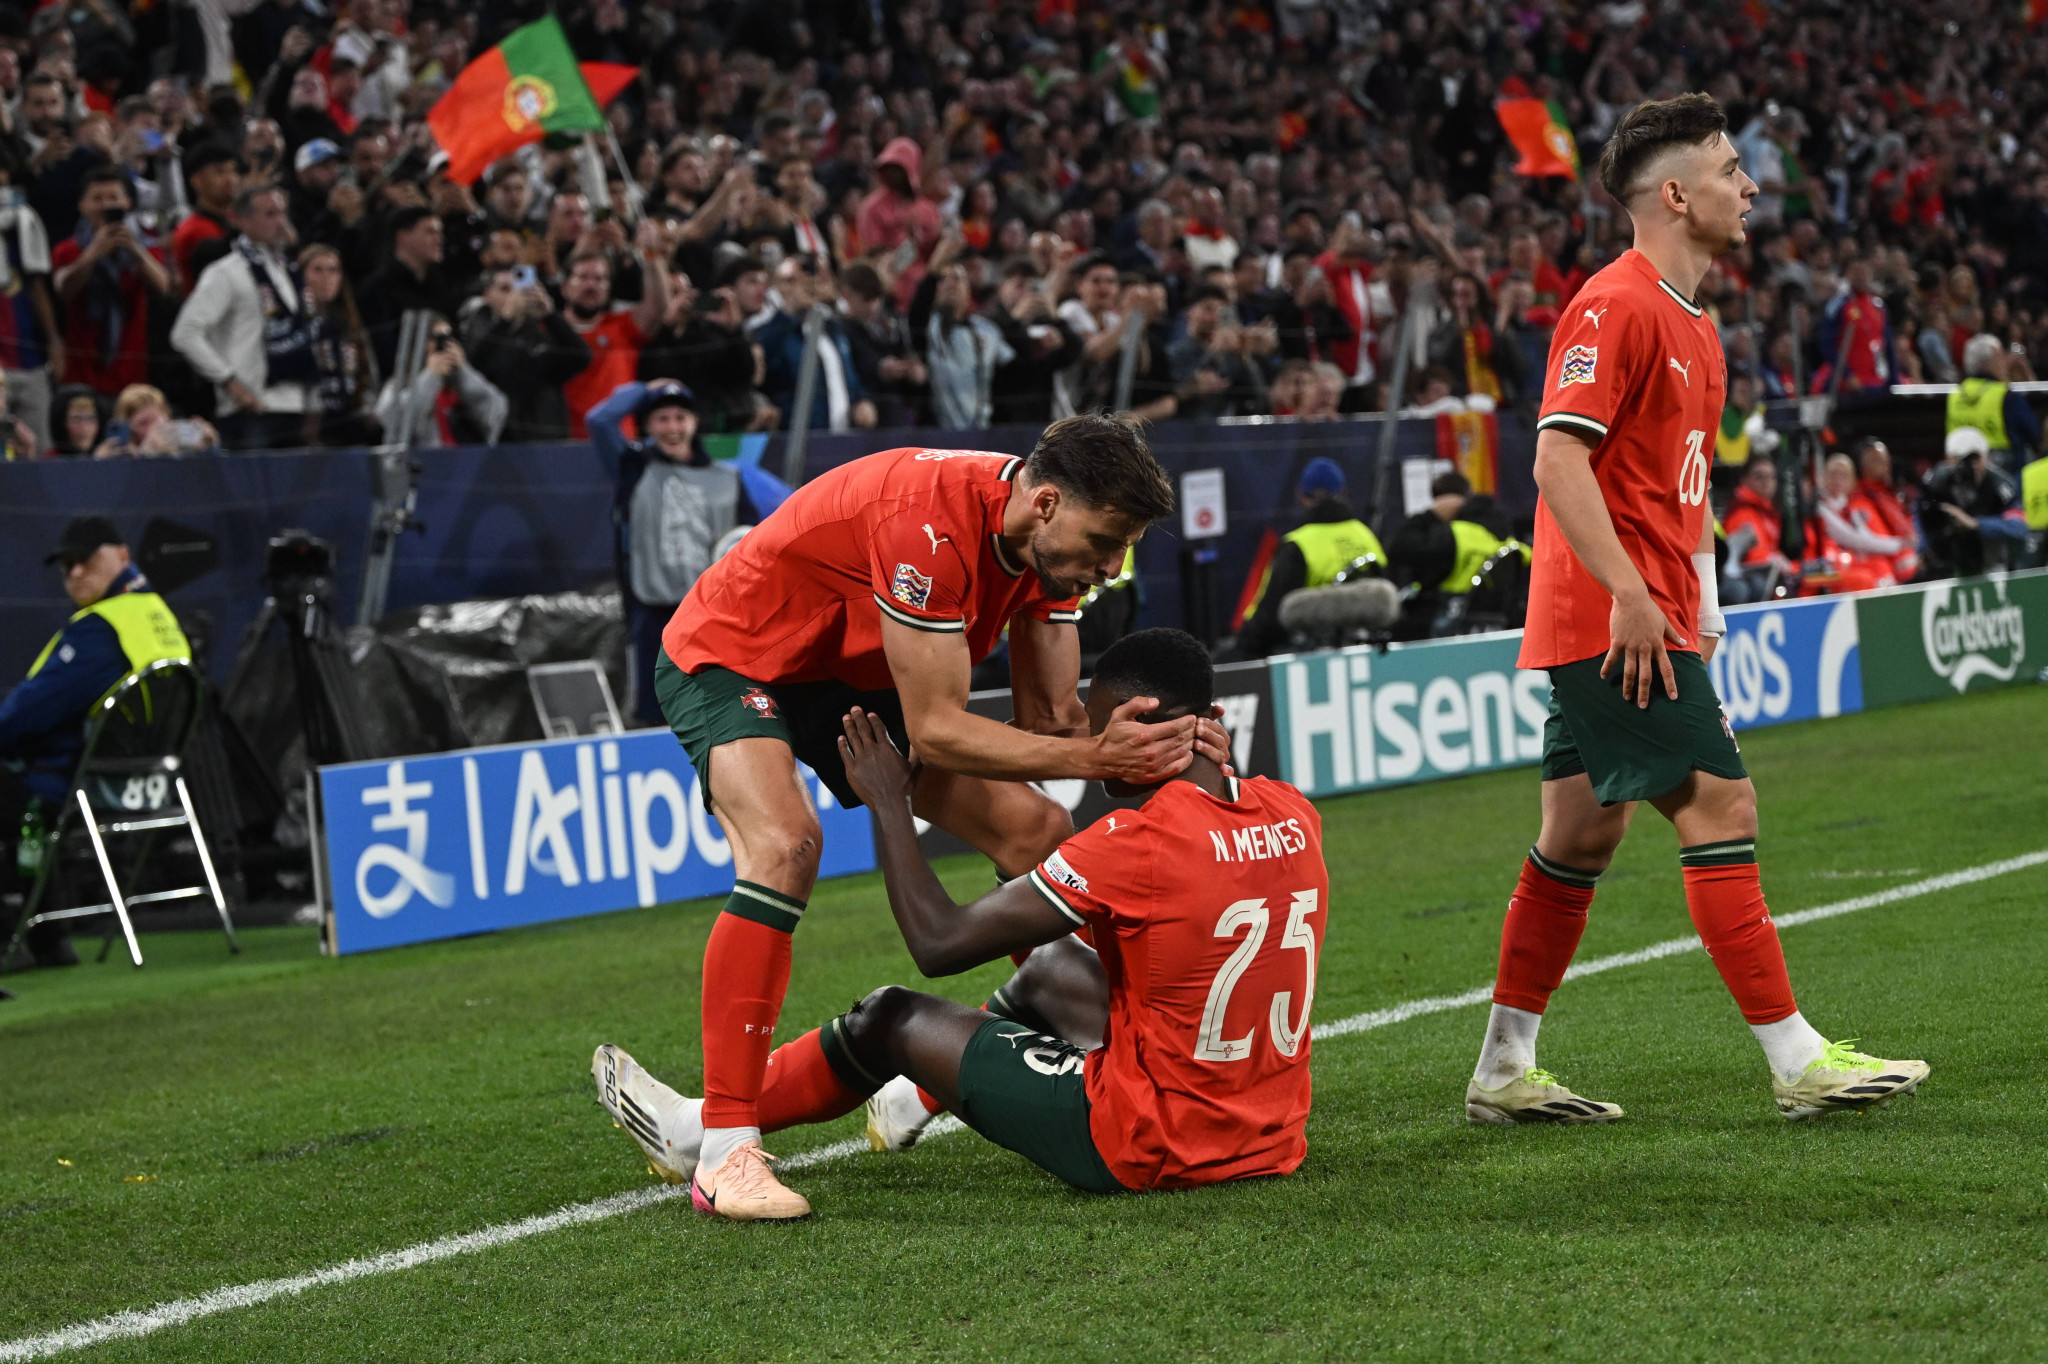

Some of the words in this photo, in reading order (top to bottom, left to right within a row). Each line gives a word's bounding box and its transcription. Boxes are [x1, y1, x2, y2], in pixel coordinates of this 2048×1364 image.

[1678, 429, 1708, 507] 26
[1921, 580, 2025, 694] Carlsberg
[1286, 655, 1553, 792] Hisens
[1193, 887, 1318, 1062] 25
[603, 1050, 618, 1108] F50
